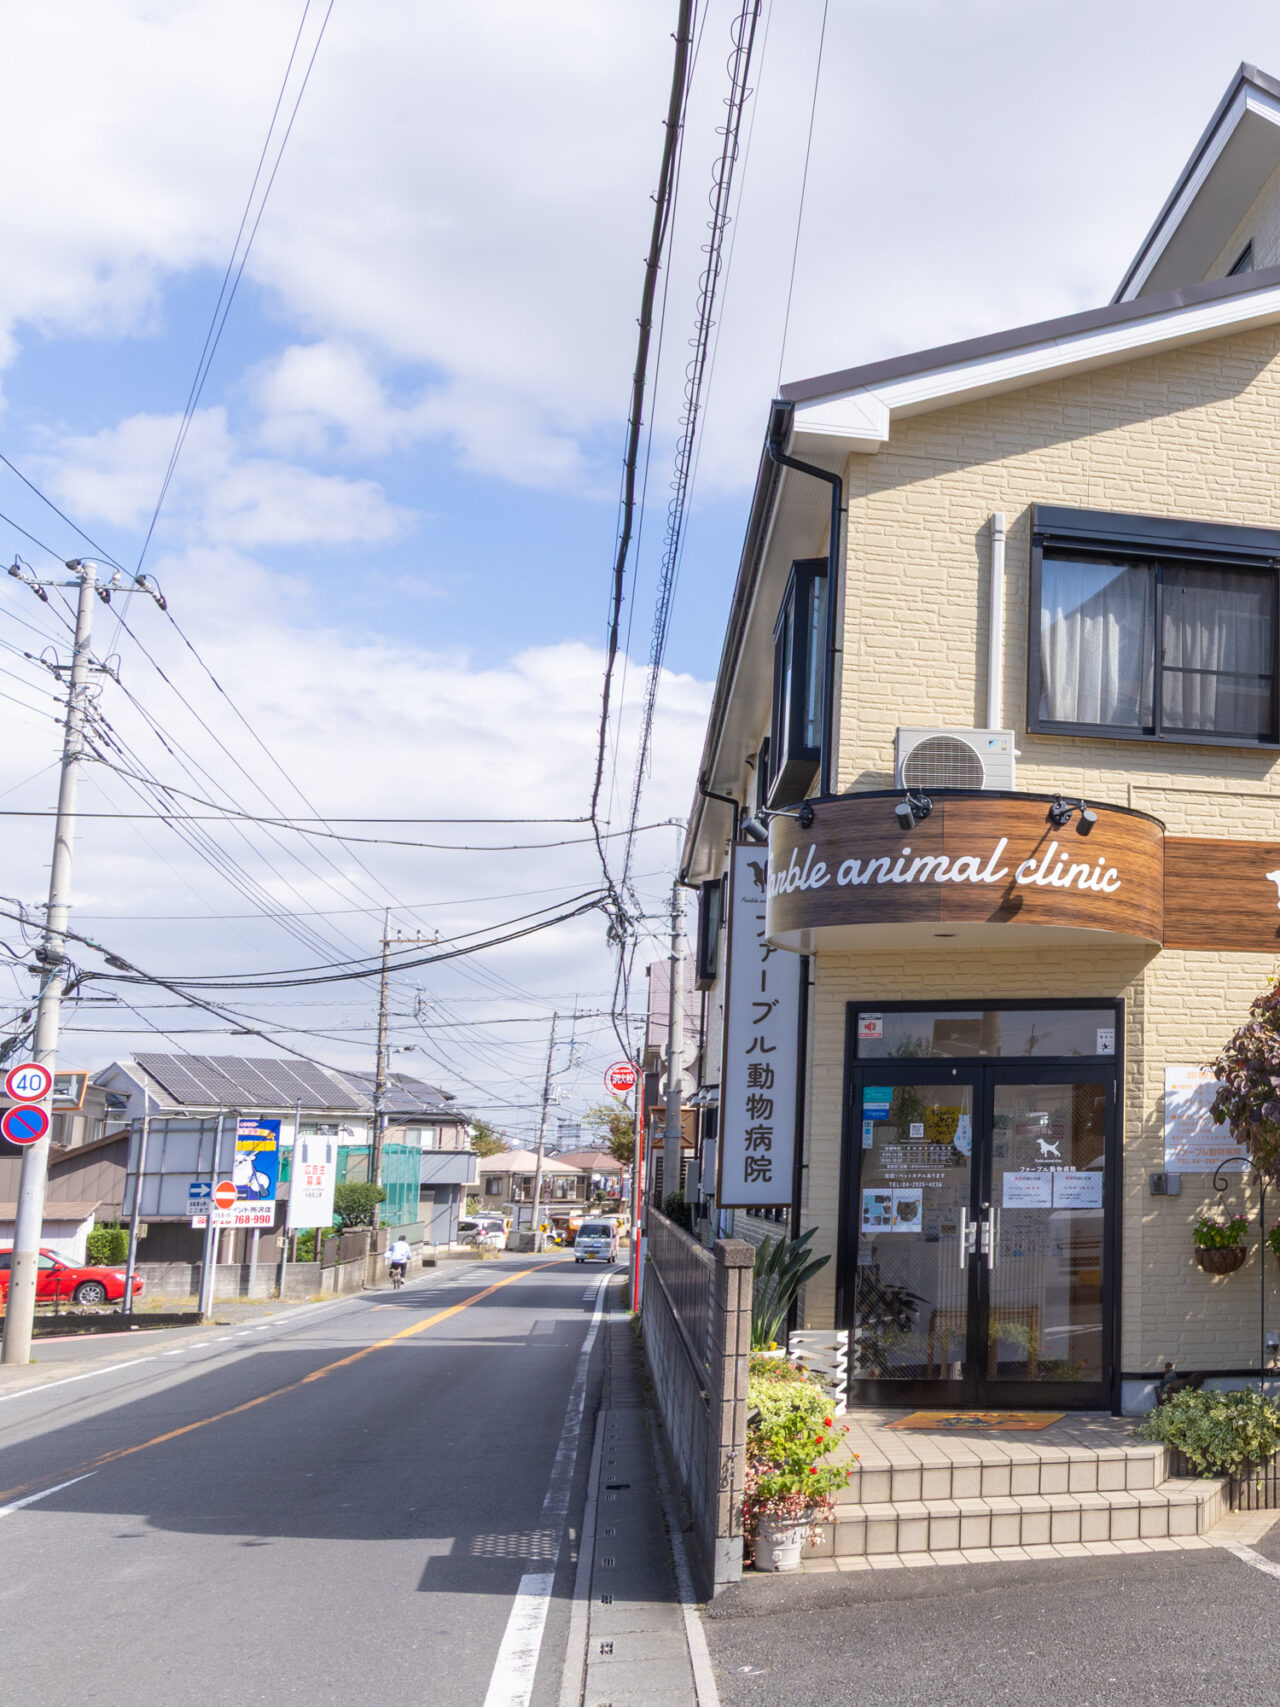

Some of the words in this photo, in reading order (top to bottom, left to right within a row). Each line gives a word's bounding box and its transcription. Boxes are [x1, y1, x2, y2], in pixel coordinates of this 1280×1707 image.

[837, 837, 1009, 885] animal
[1015, 841, 1122, 893] clinic
[16, 1074, 41, 1091] 40
